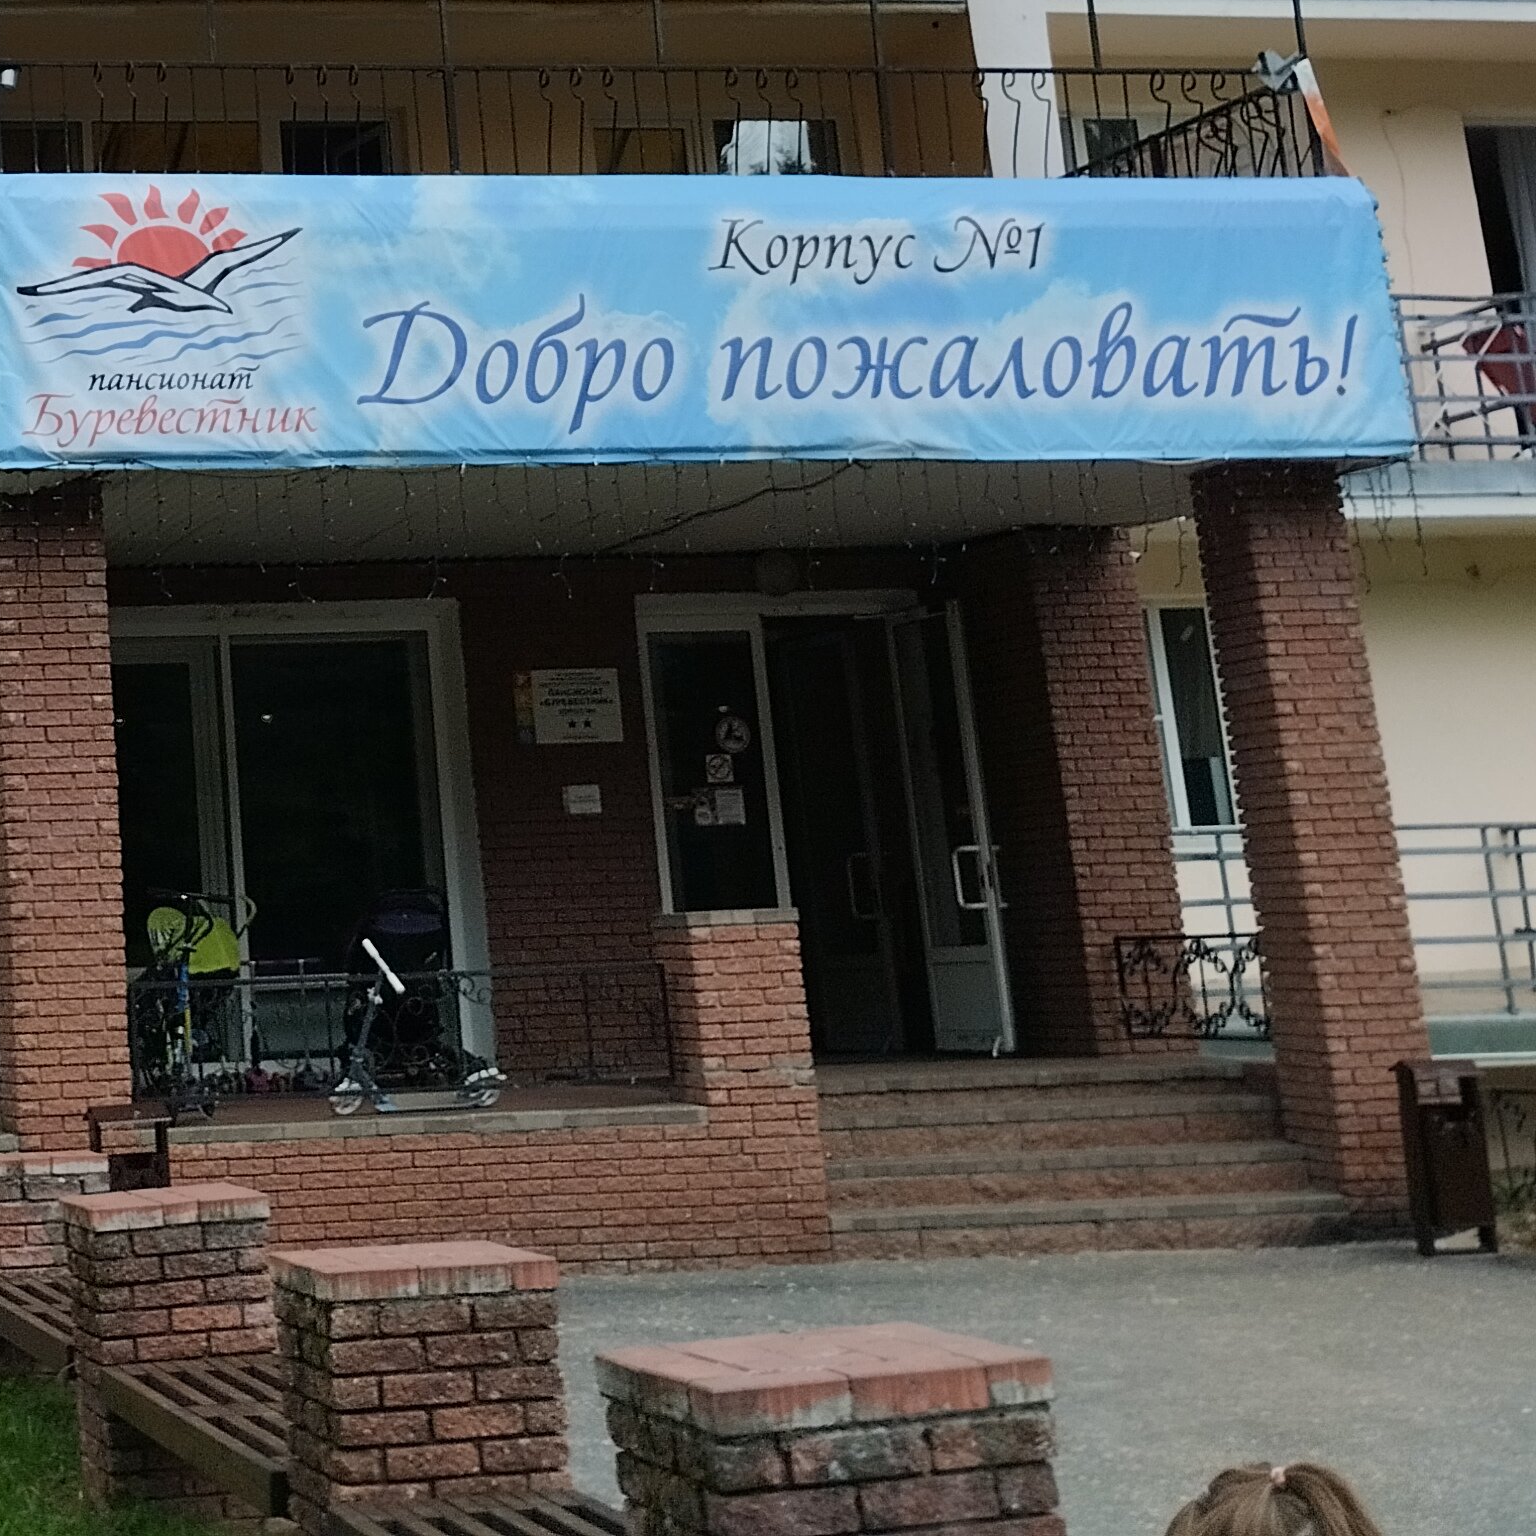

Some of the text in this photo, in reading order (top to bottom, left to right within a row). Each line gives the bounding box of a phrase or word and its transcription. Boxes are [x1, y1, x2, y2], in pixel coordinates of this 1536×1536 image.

[708, 215, 1045, 286] Корпус №1
[87, 364, 260, 391] пансионат
[356, 292, 1359, 435] Добро пожаловать!
[21, 393, 318, 448] Буревестник
